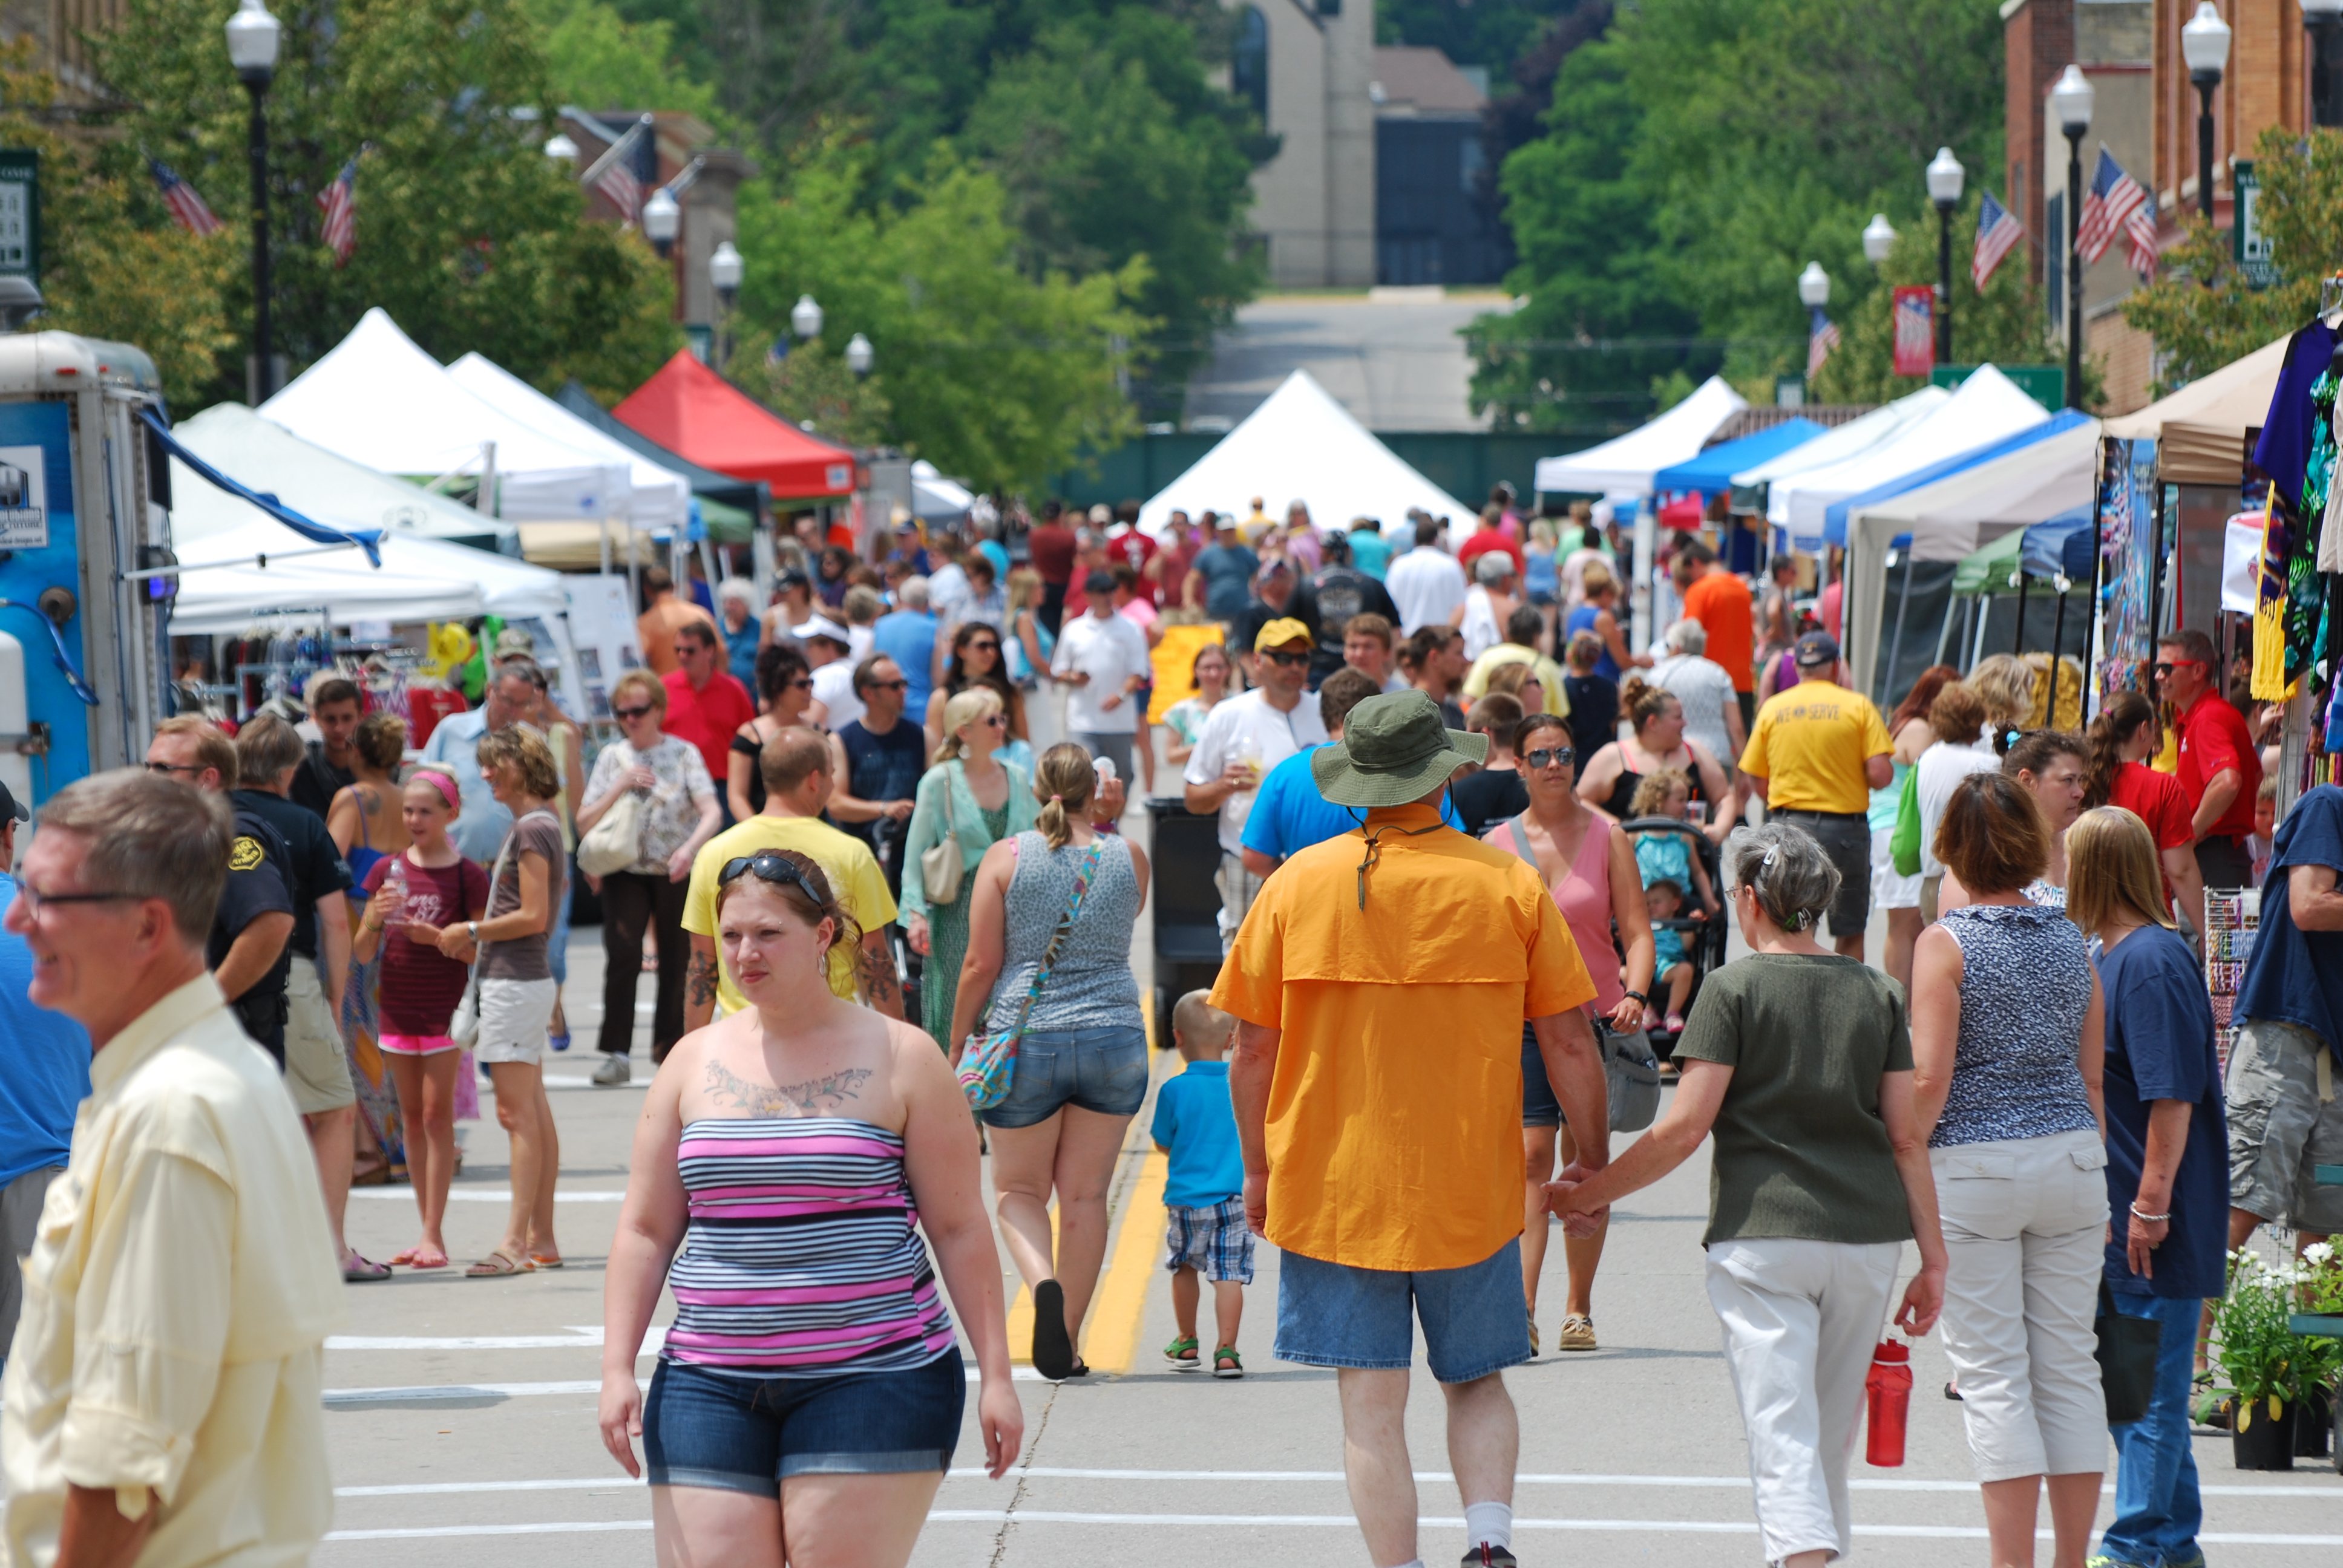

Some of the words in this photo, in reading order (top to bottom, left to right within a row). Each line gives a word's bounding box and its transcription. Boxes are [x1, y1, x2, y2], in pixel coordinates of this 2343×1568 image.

[1776, 707, 1791, 725] WE
[1807, 703, 1840, 721] SERVE
[233, 841, 254, 854] OLICE
[407, 893, 440, 908] ero
